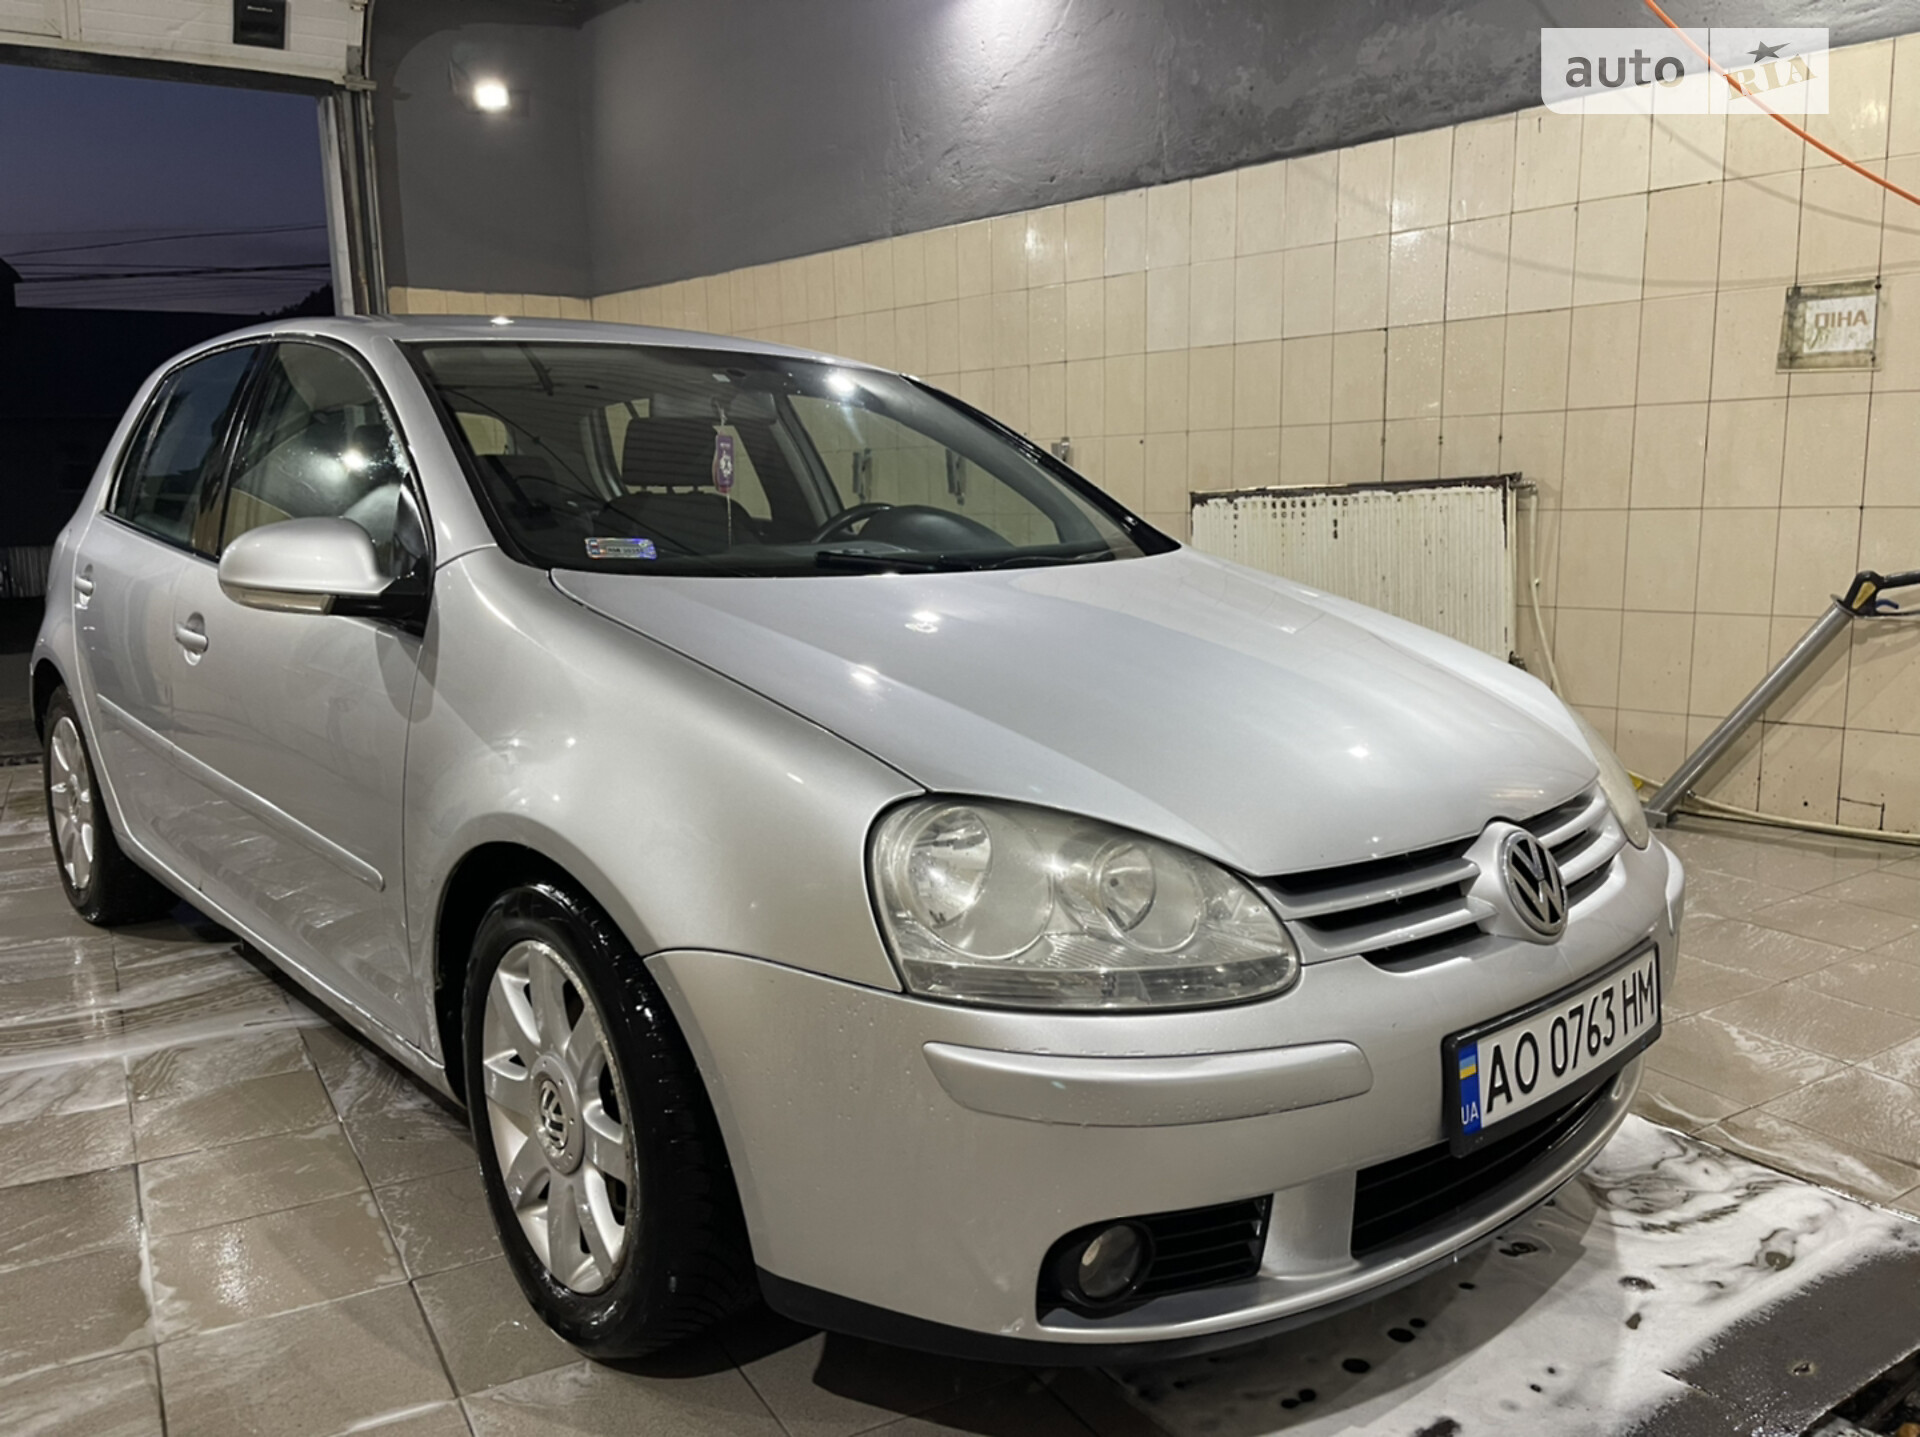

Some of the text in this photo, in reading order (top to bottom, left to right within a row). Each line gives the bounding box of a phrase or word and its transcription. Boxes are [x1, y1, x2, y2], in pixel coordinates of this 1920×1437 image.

[1486, 1032, 1540, 1114] AO
[1550, 985, 1616, 1078] 0763
[1460, 1101, 1479, 1126] UA
